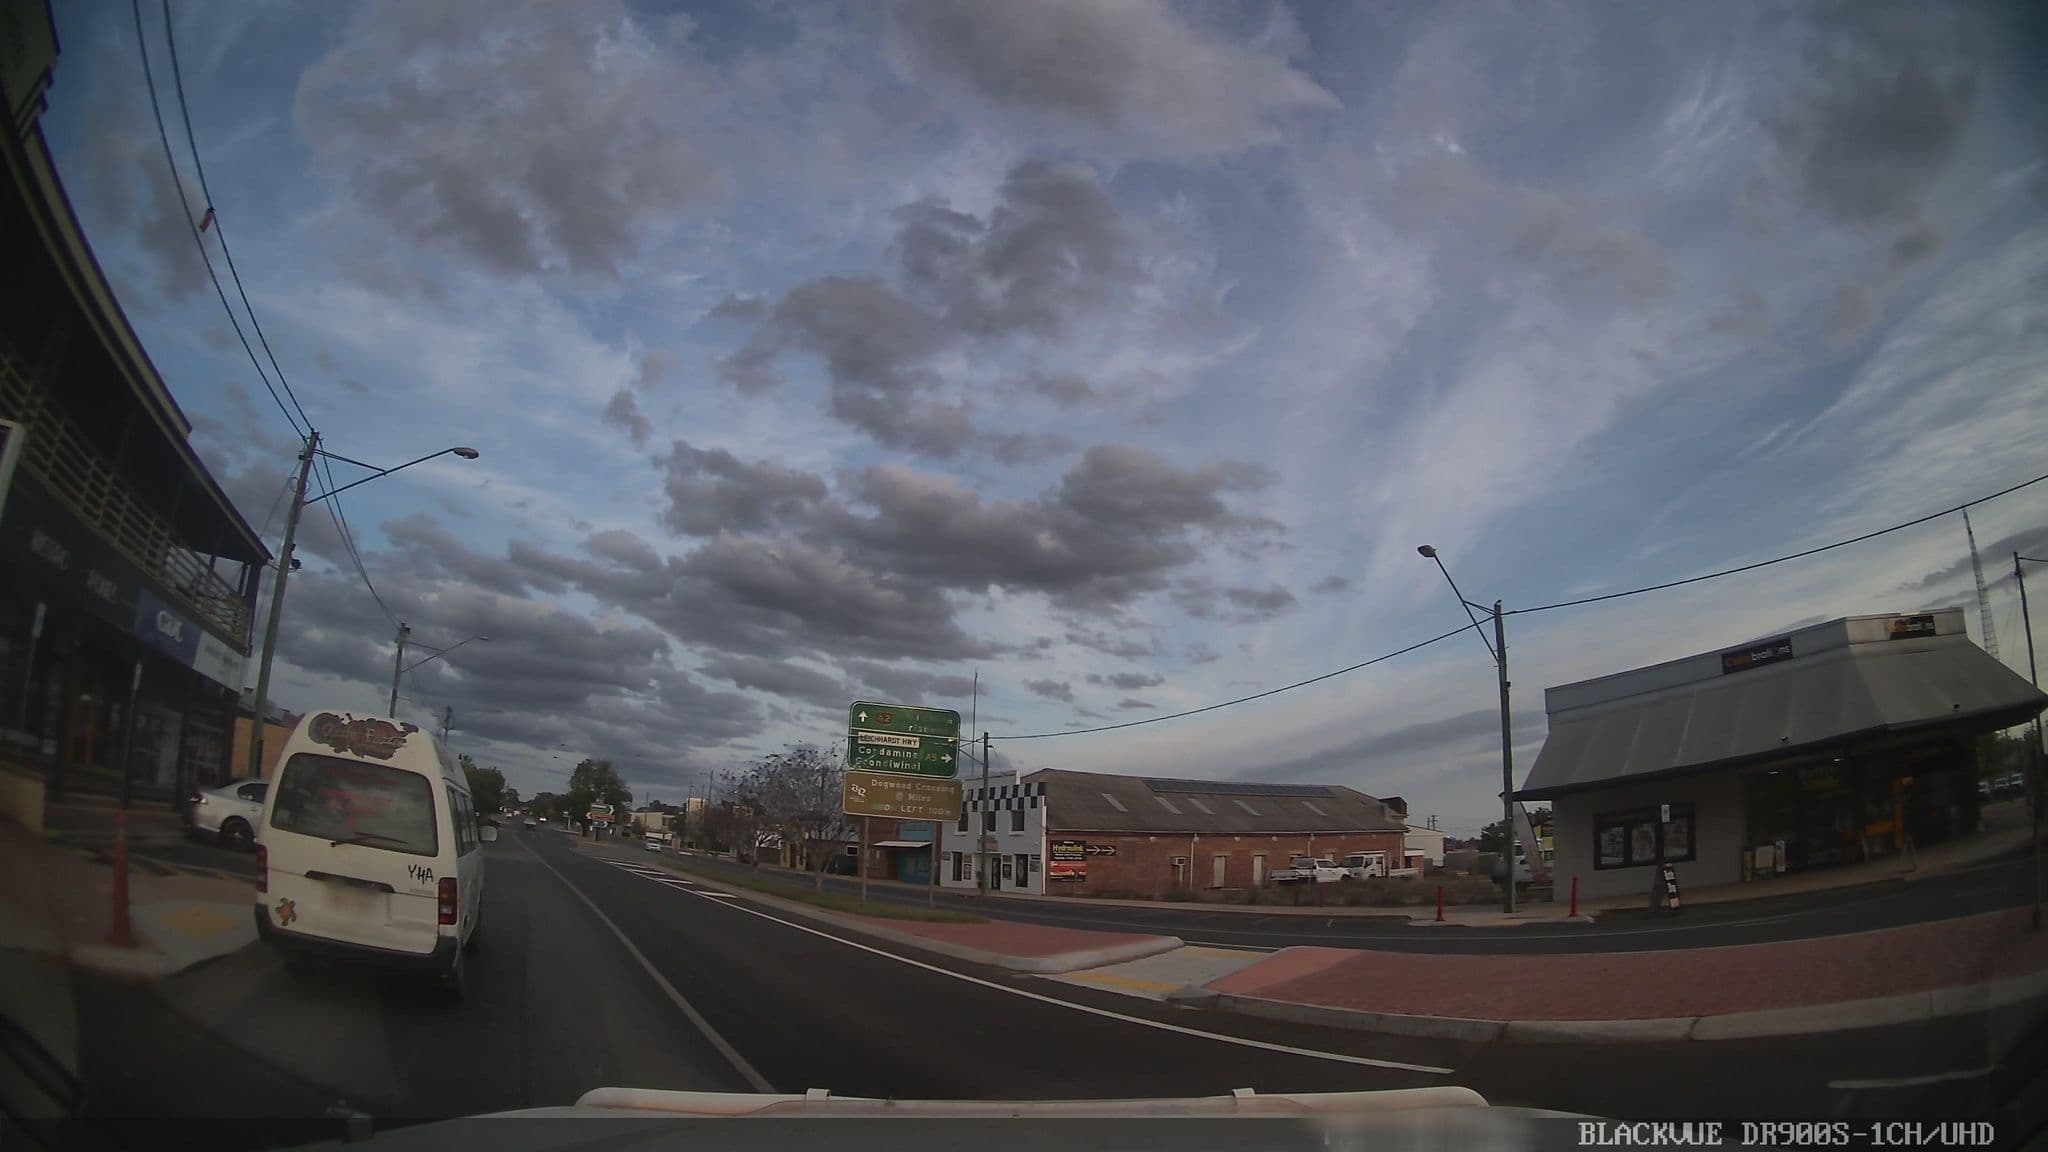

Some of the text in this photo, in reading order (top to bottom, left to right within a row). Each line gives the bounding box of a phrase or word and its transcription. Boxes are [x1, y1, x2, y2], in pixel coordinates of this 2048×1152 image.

[902, 738, 917, 746] HWY
[871, 779, 911, 790] Dogwood
[915, 783, 955, 795] Crossing
[908, 793, 931, 802] Miles
[901, 805, 923, 813] LEFT
[408, 864, 434, 885] YHA
